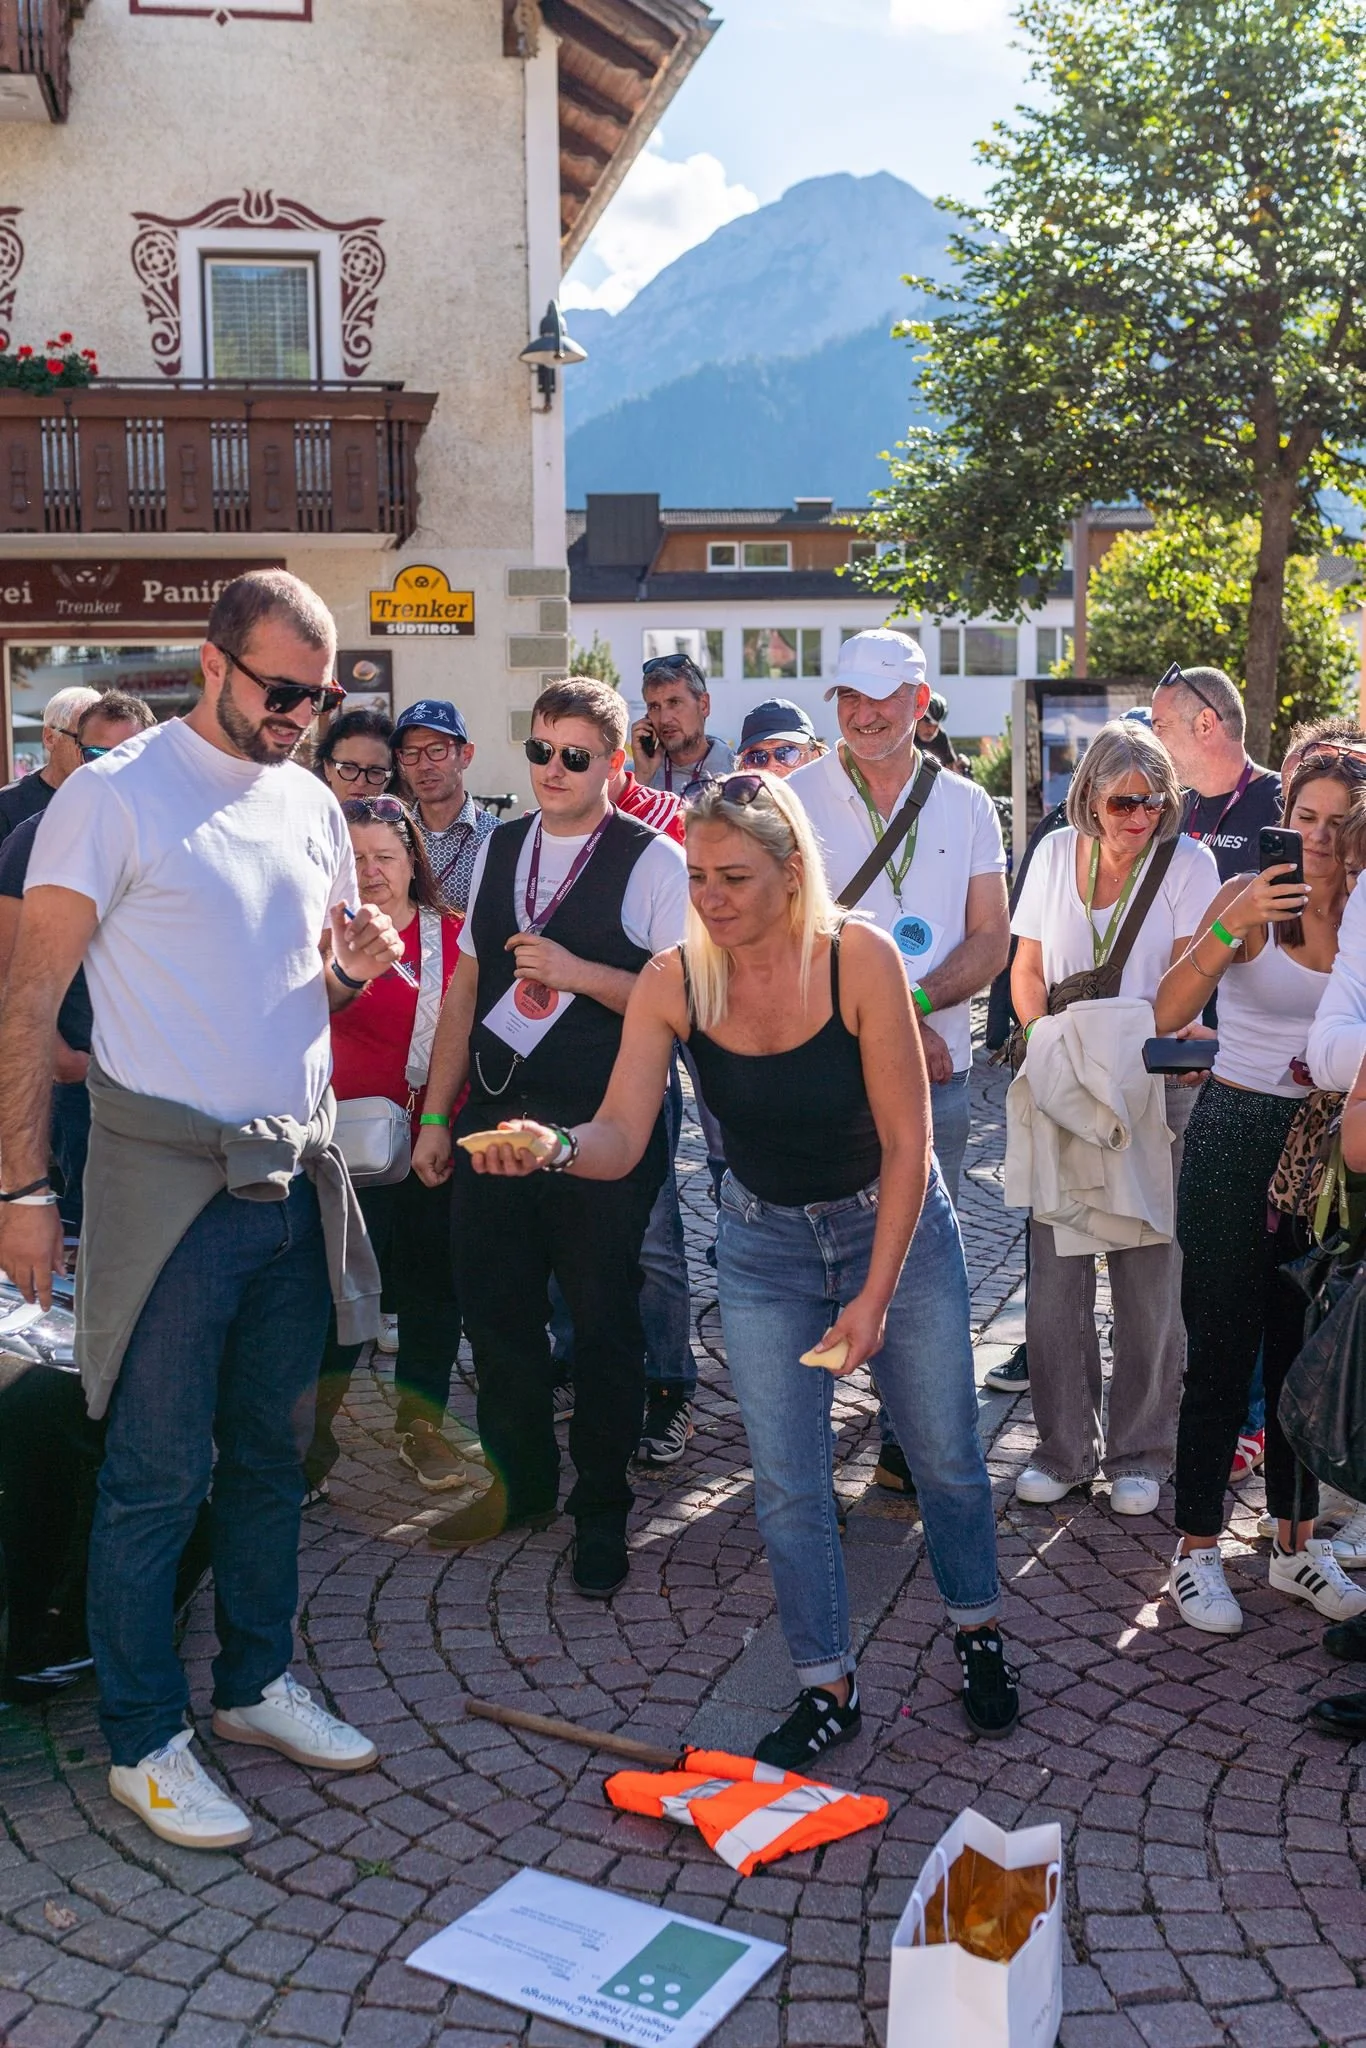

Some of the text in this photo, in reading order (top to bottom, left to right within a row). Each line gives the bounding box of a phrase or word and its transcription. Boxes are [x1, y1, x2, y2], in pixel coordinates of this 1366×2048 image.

[0, 581, 33, 604] ei
[142, 580, 231, 604] Panif
[56, 600, 122, 614] Trenker
[376, 599, 468, 618] Trenker
[386, 621, 460, 634] SÜDTIROL
